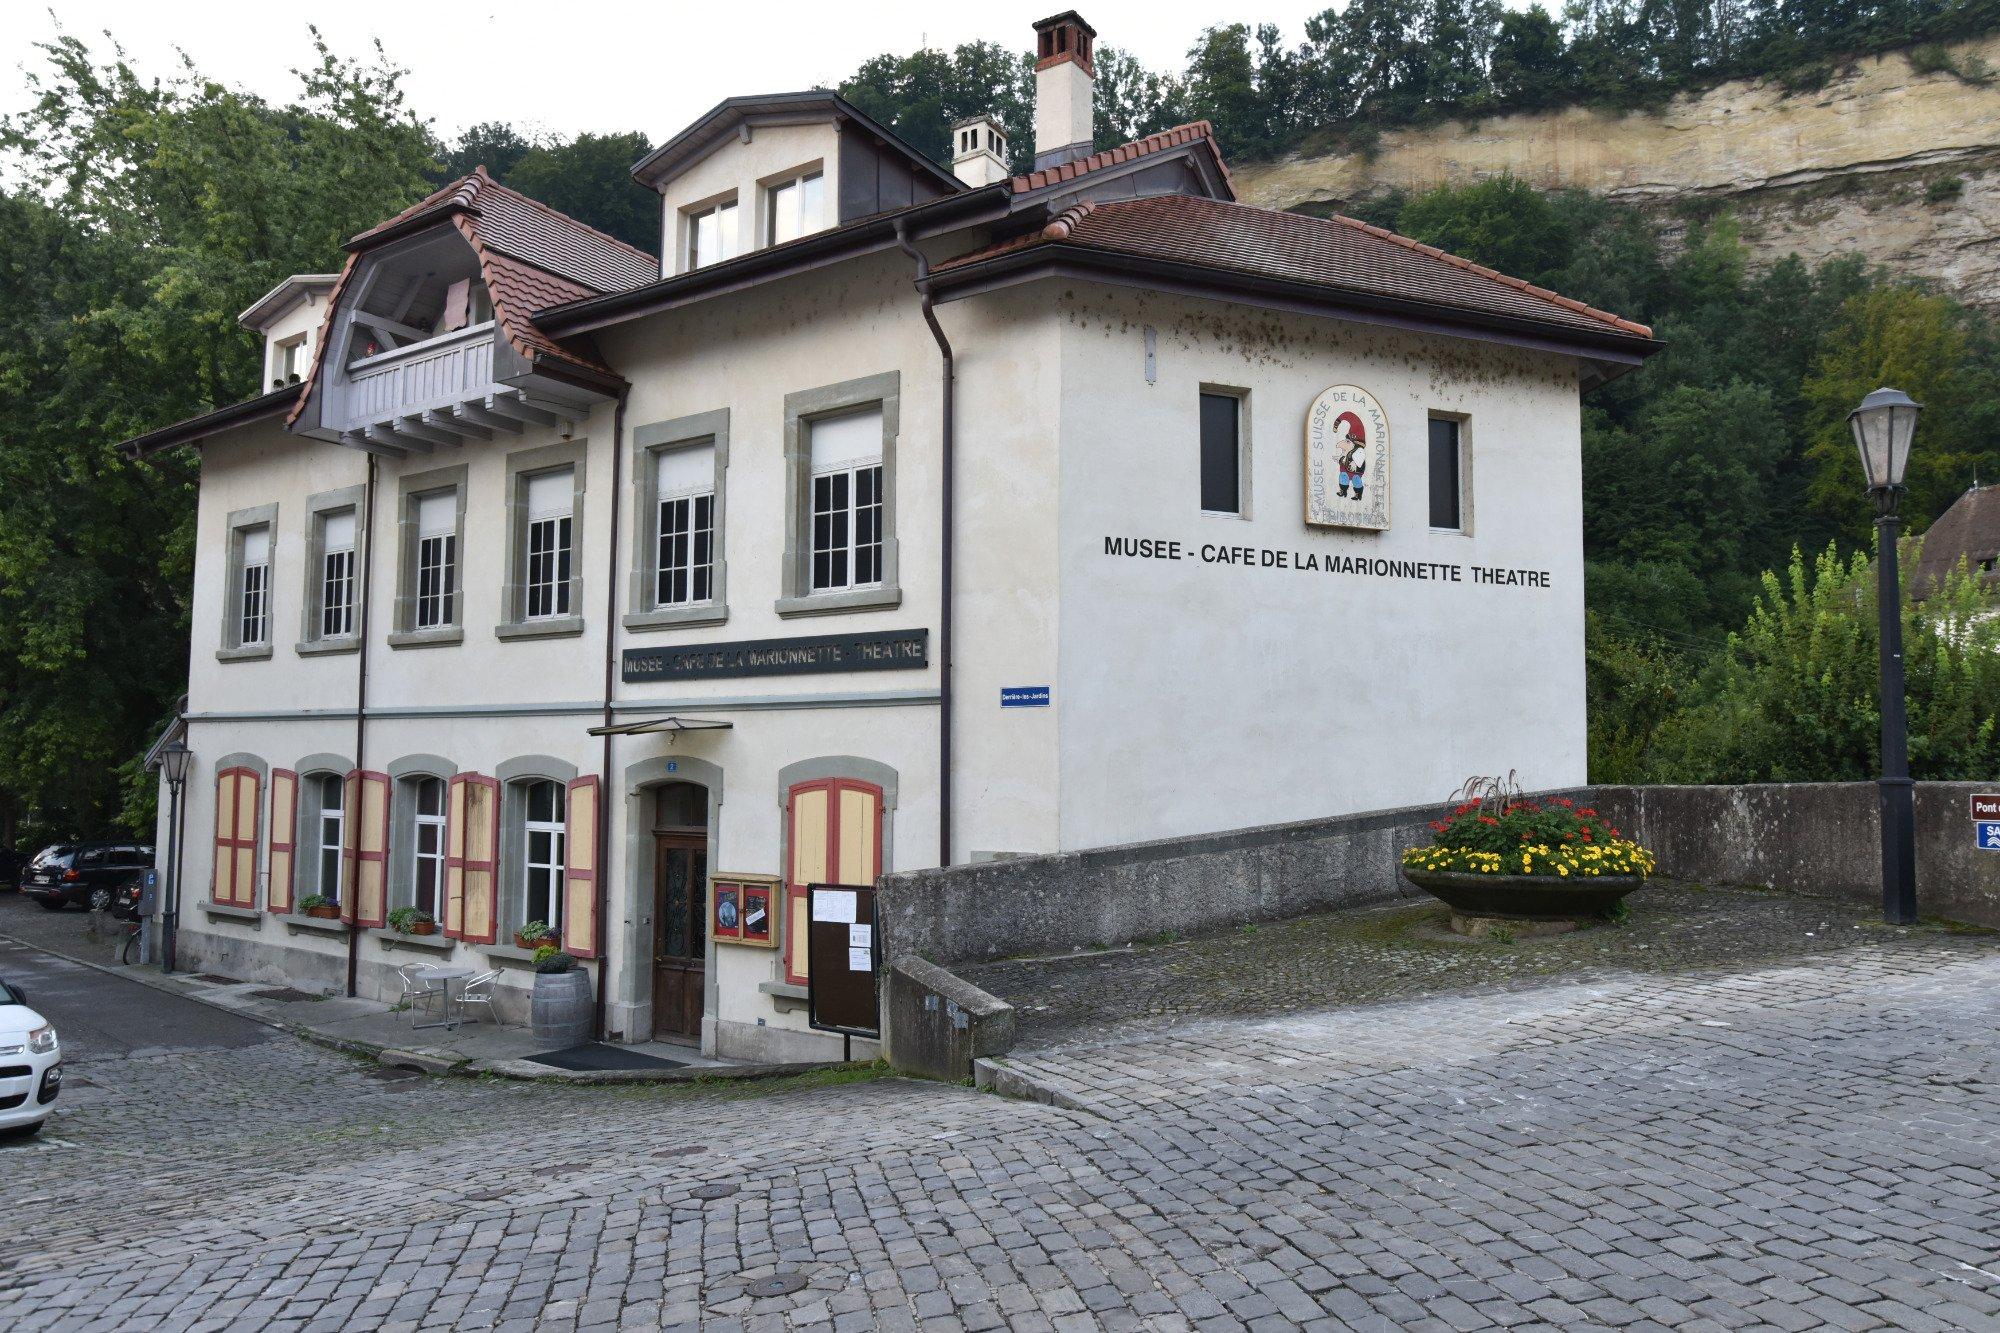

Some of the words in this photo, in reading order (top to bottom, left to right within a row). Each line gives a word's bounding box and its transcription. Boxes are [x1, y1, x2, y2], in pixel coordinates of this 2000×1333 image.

[1332, 391, 1347, 403] DE
[1352, 392, 1367, 408] LA
[1313, 400, 1330, 451] SUISSE
[1313, 459, 1325, 506] MUSEE
[1104, 536, 1182, 560] MUSEE
[1201, 543, 1256, 566] CAFE
[1261, 549, 1288, 569] DE
[1294, 551, 1320, 572] LA
[1325, 554, 1462, 582] MARIONNETTE
[1470, 566, 1551, 588] THEATRE
[624, 656, 663, 673] MUSEE
[673, 652, 704, 670] CAFE
[708, 651, 724, 668] DE
[728, 650, 744, 667] LA
[748, 643, 842, 667] MARIONNETTE
[855, 638, 922, 661] THEATRE
[1976, 802, 1997, 812] Pont
